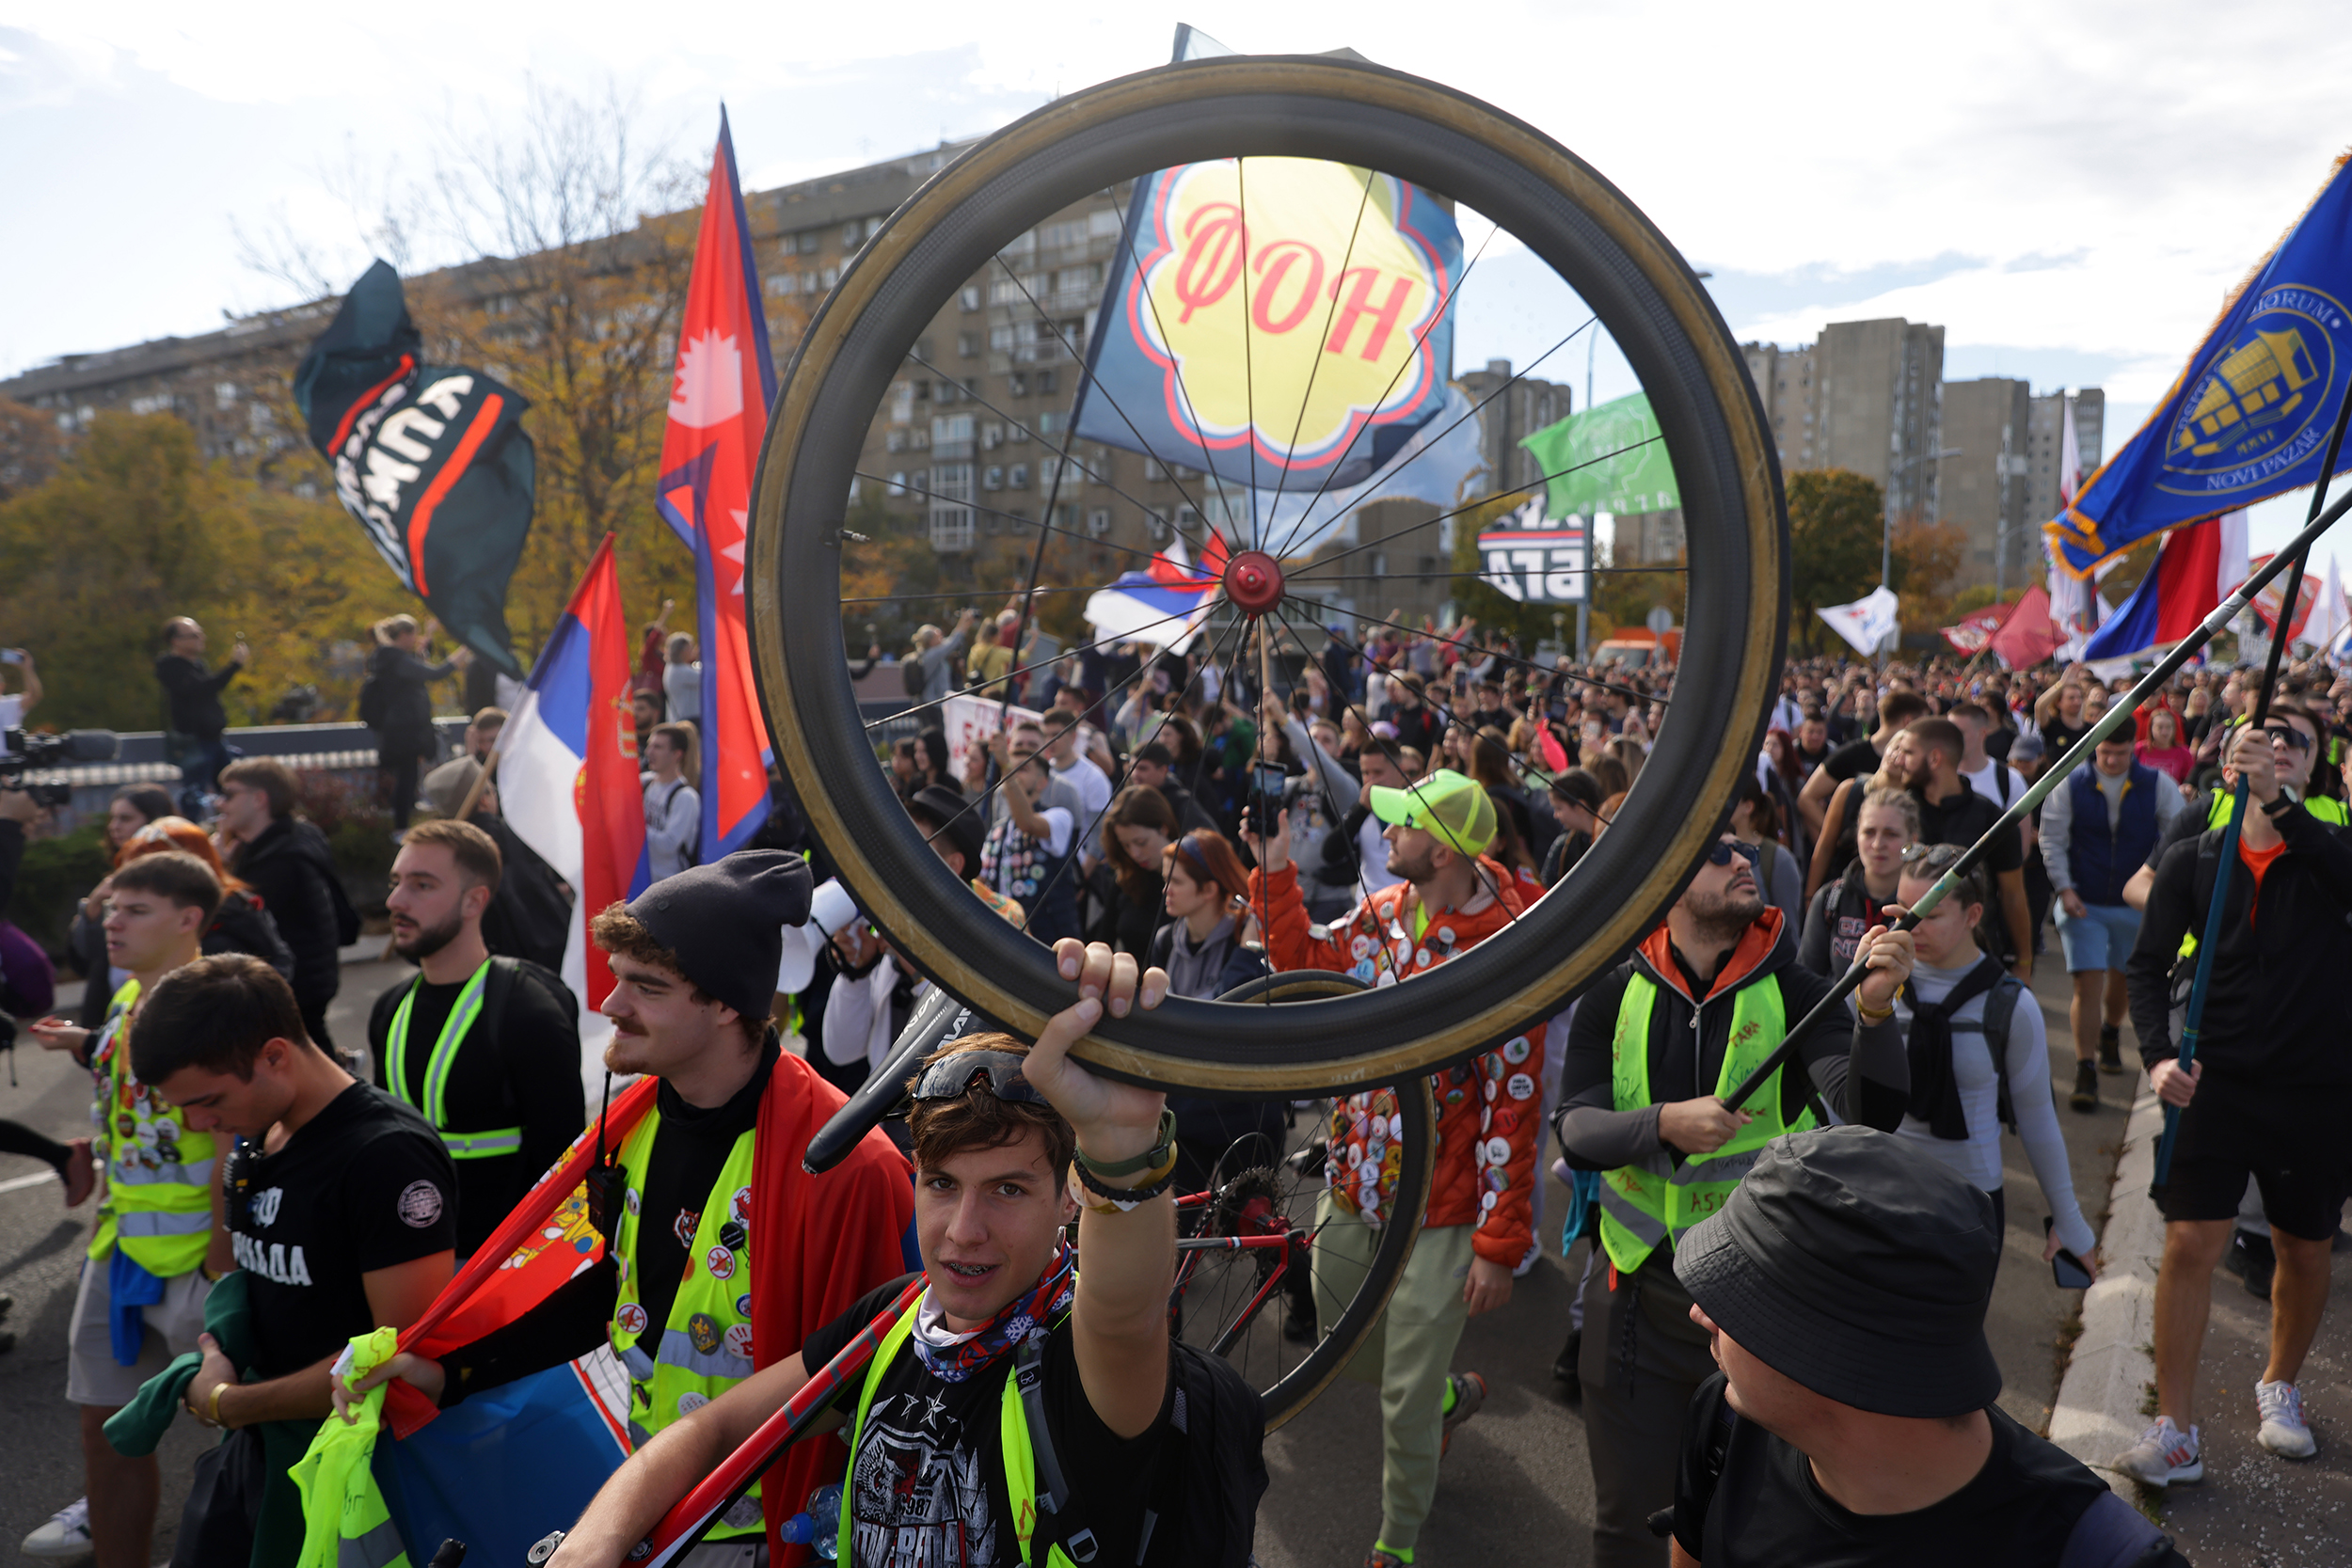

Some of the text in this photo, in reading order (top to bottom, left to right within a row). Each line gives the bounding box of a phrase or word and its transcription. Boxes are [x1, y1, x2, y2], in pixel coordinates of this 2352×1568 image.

[1174, 202, 1415, 362] ФОН
[2206, 426, 2322, 490] NOVI PAZAR
